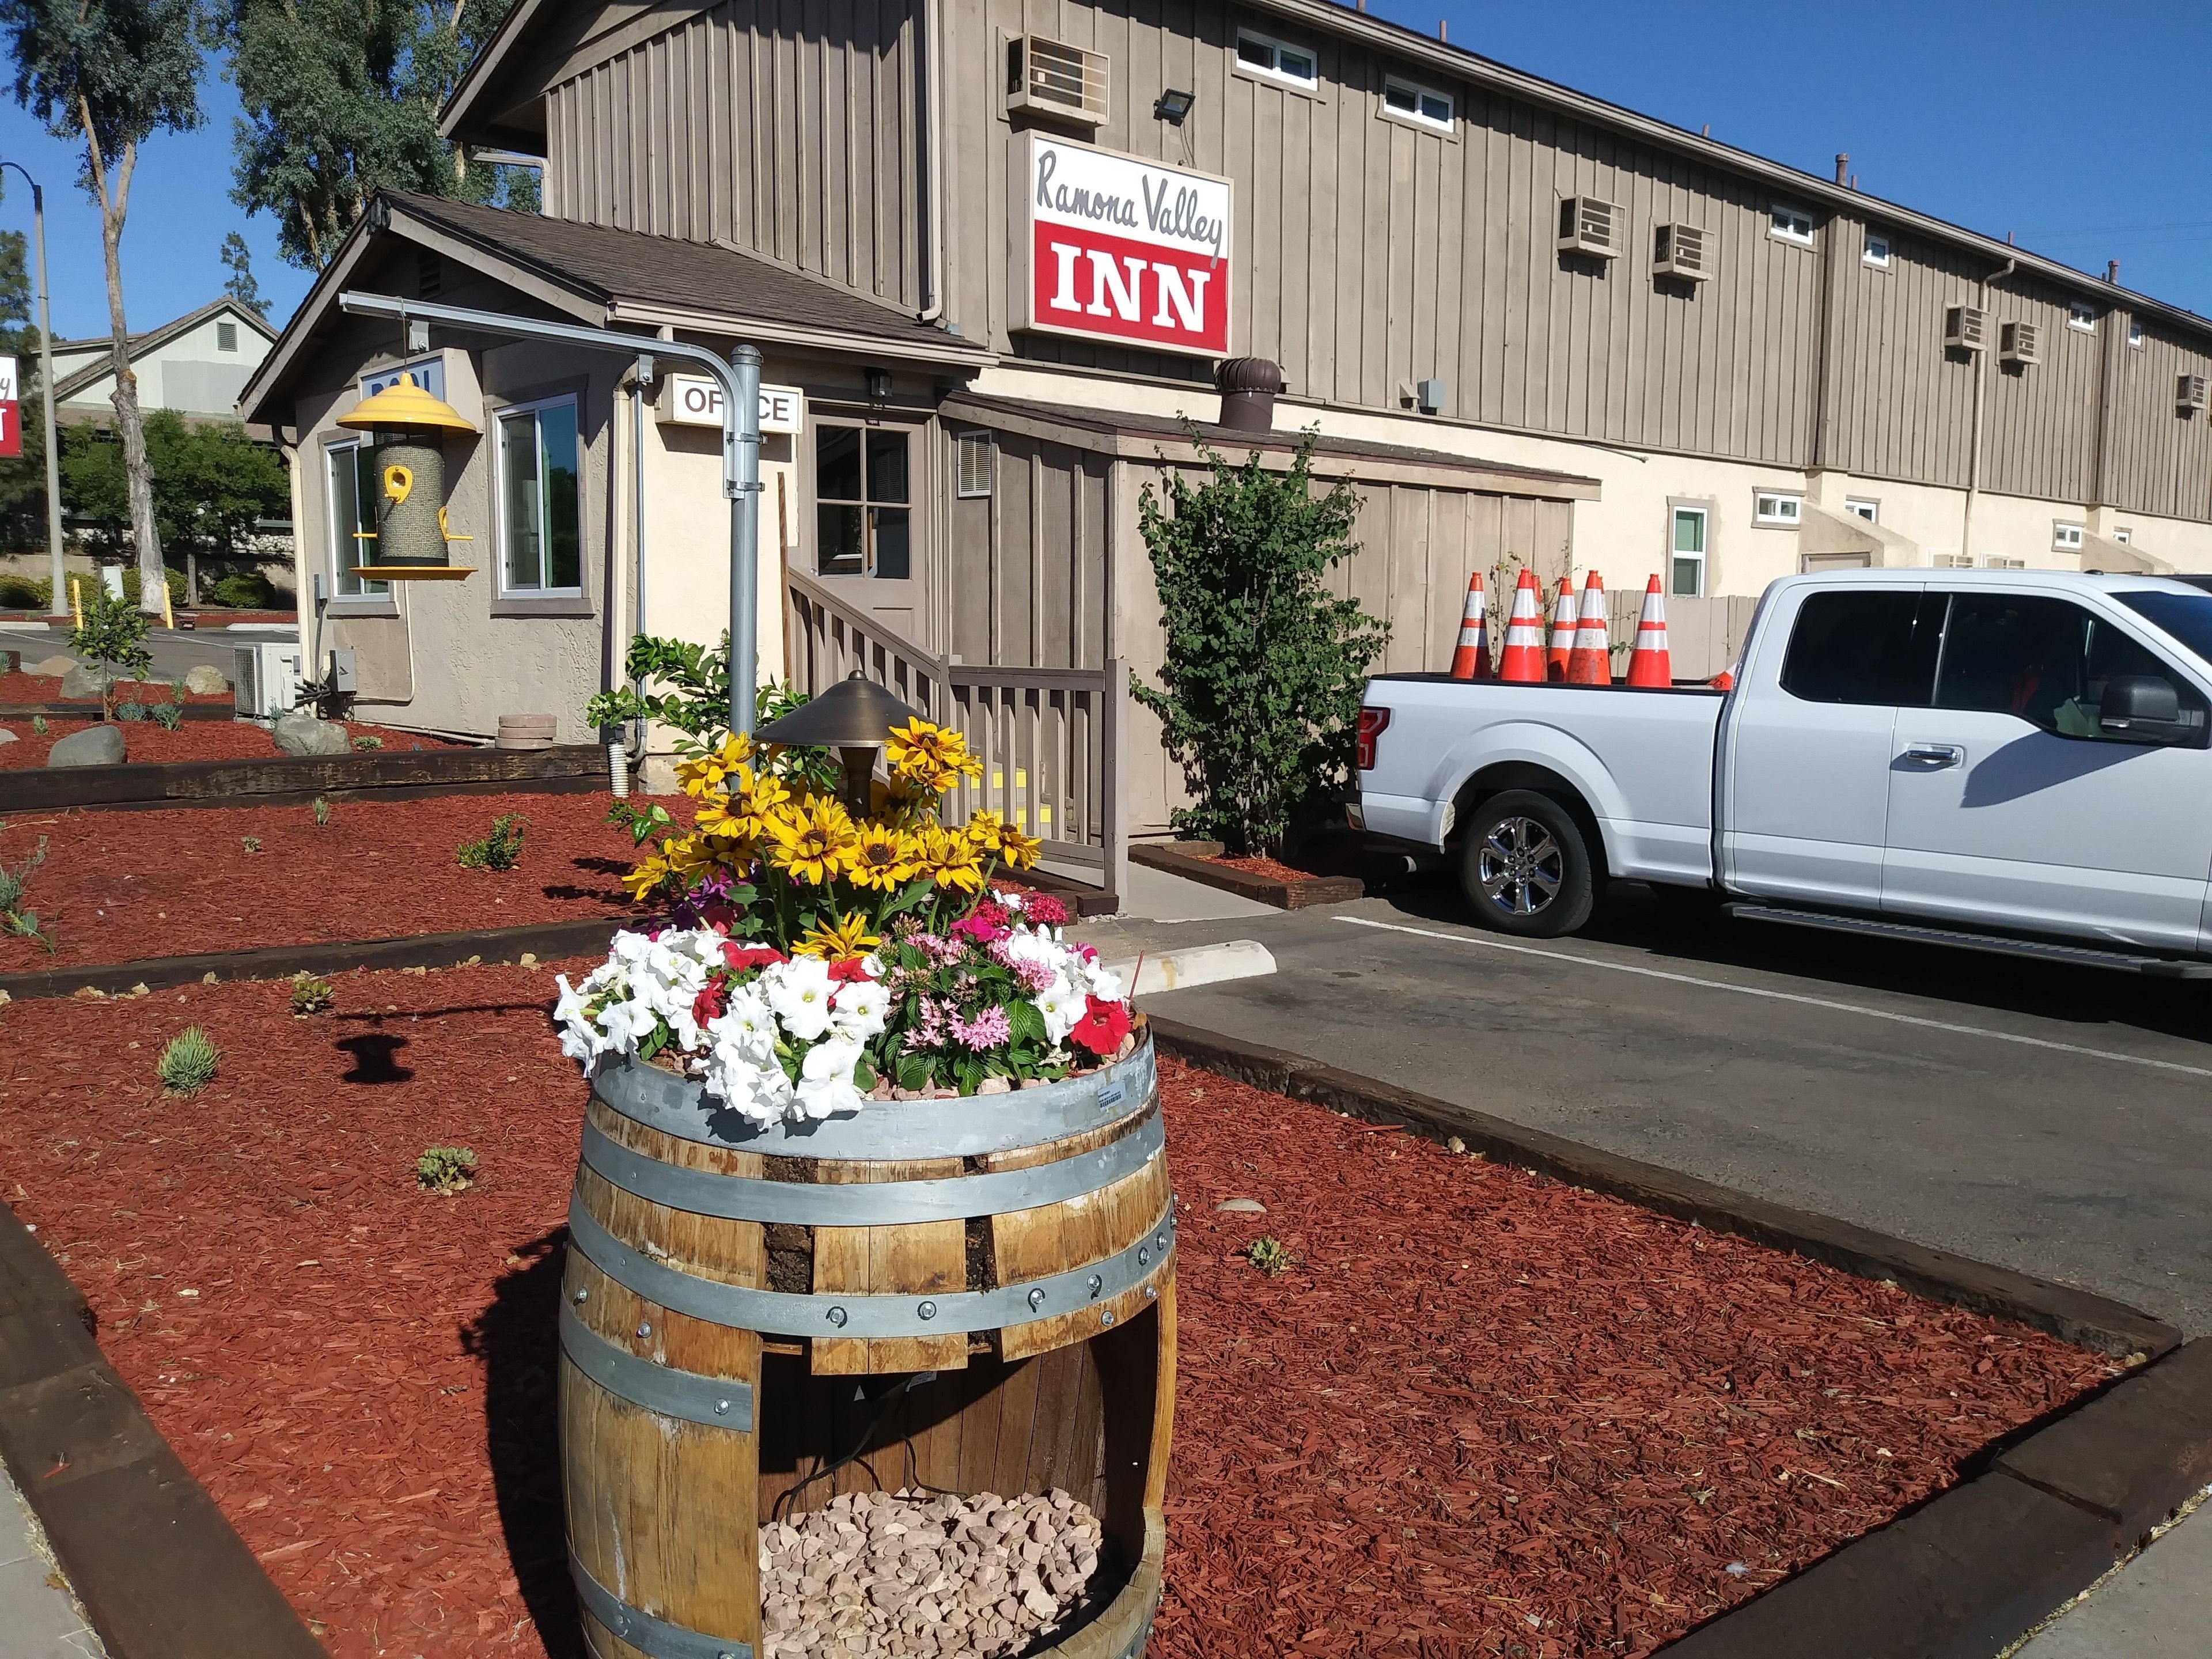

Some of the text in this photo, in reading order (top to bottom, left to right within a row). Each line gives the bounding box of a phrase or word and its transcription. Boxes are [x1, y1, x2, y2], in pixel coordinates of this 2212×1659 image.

[1037, 150, 1222, 270] Ramona Valley
[1050, 241, 1211, 333] INN
[684, 387, 789, 422] OFCE
